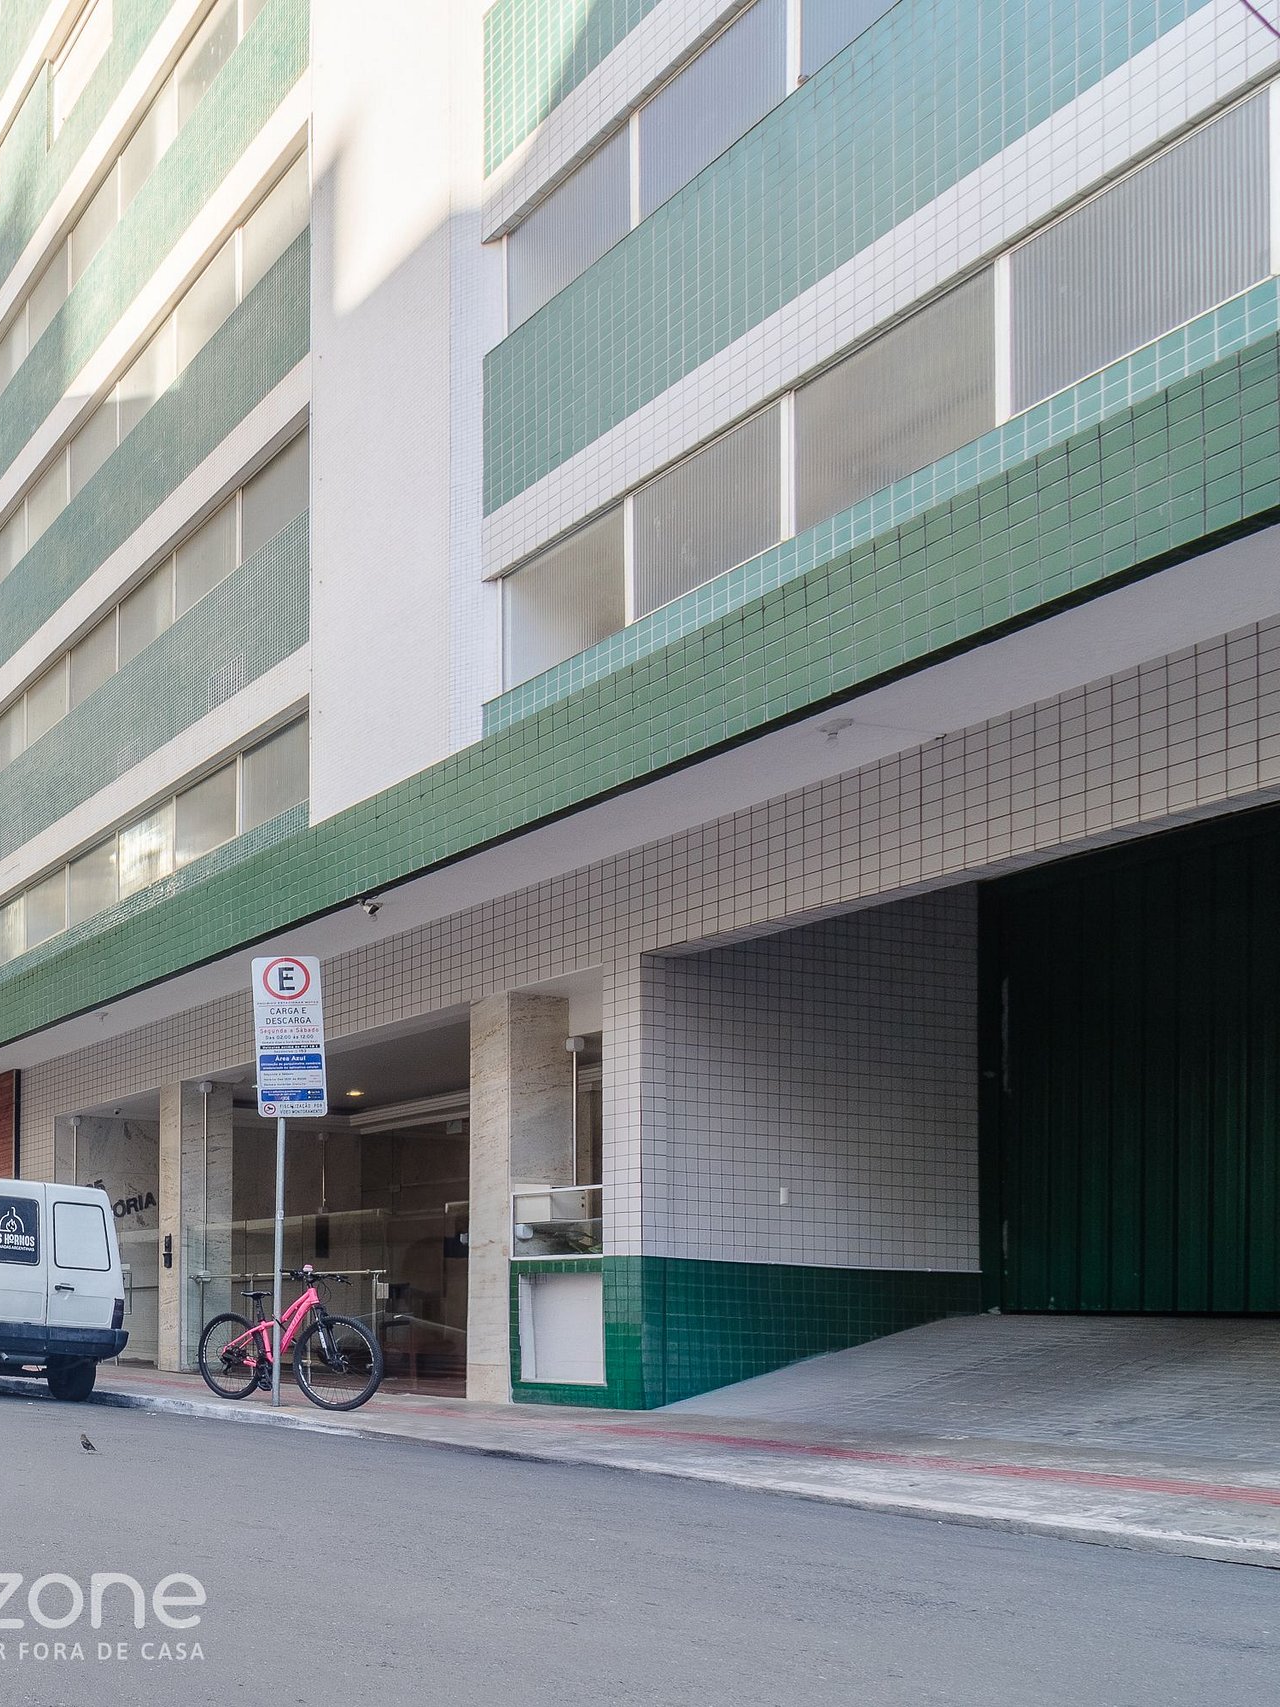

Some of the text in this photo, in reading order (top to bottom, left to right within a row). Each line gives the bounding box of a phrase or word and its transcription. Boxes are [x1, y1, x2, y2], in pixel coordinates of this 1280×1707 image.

[278, 967, 295, 991] E
[270, 1007, 299, 1015] CARGA
[265, 1017, 311, 1025] DESCARGA
[113, 1192, 156, 1217] ORIA
[4, 1233, 35, 1247] HORNOS
